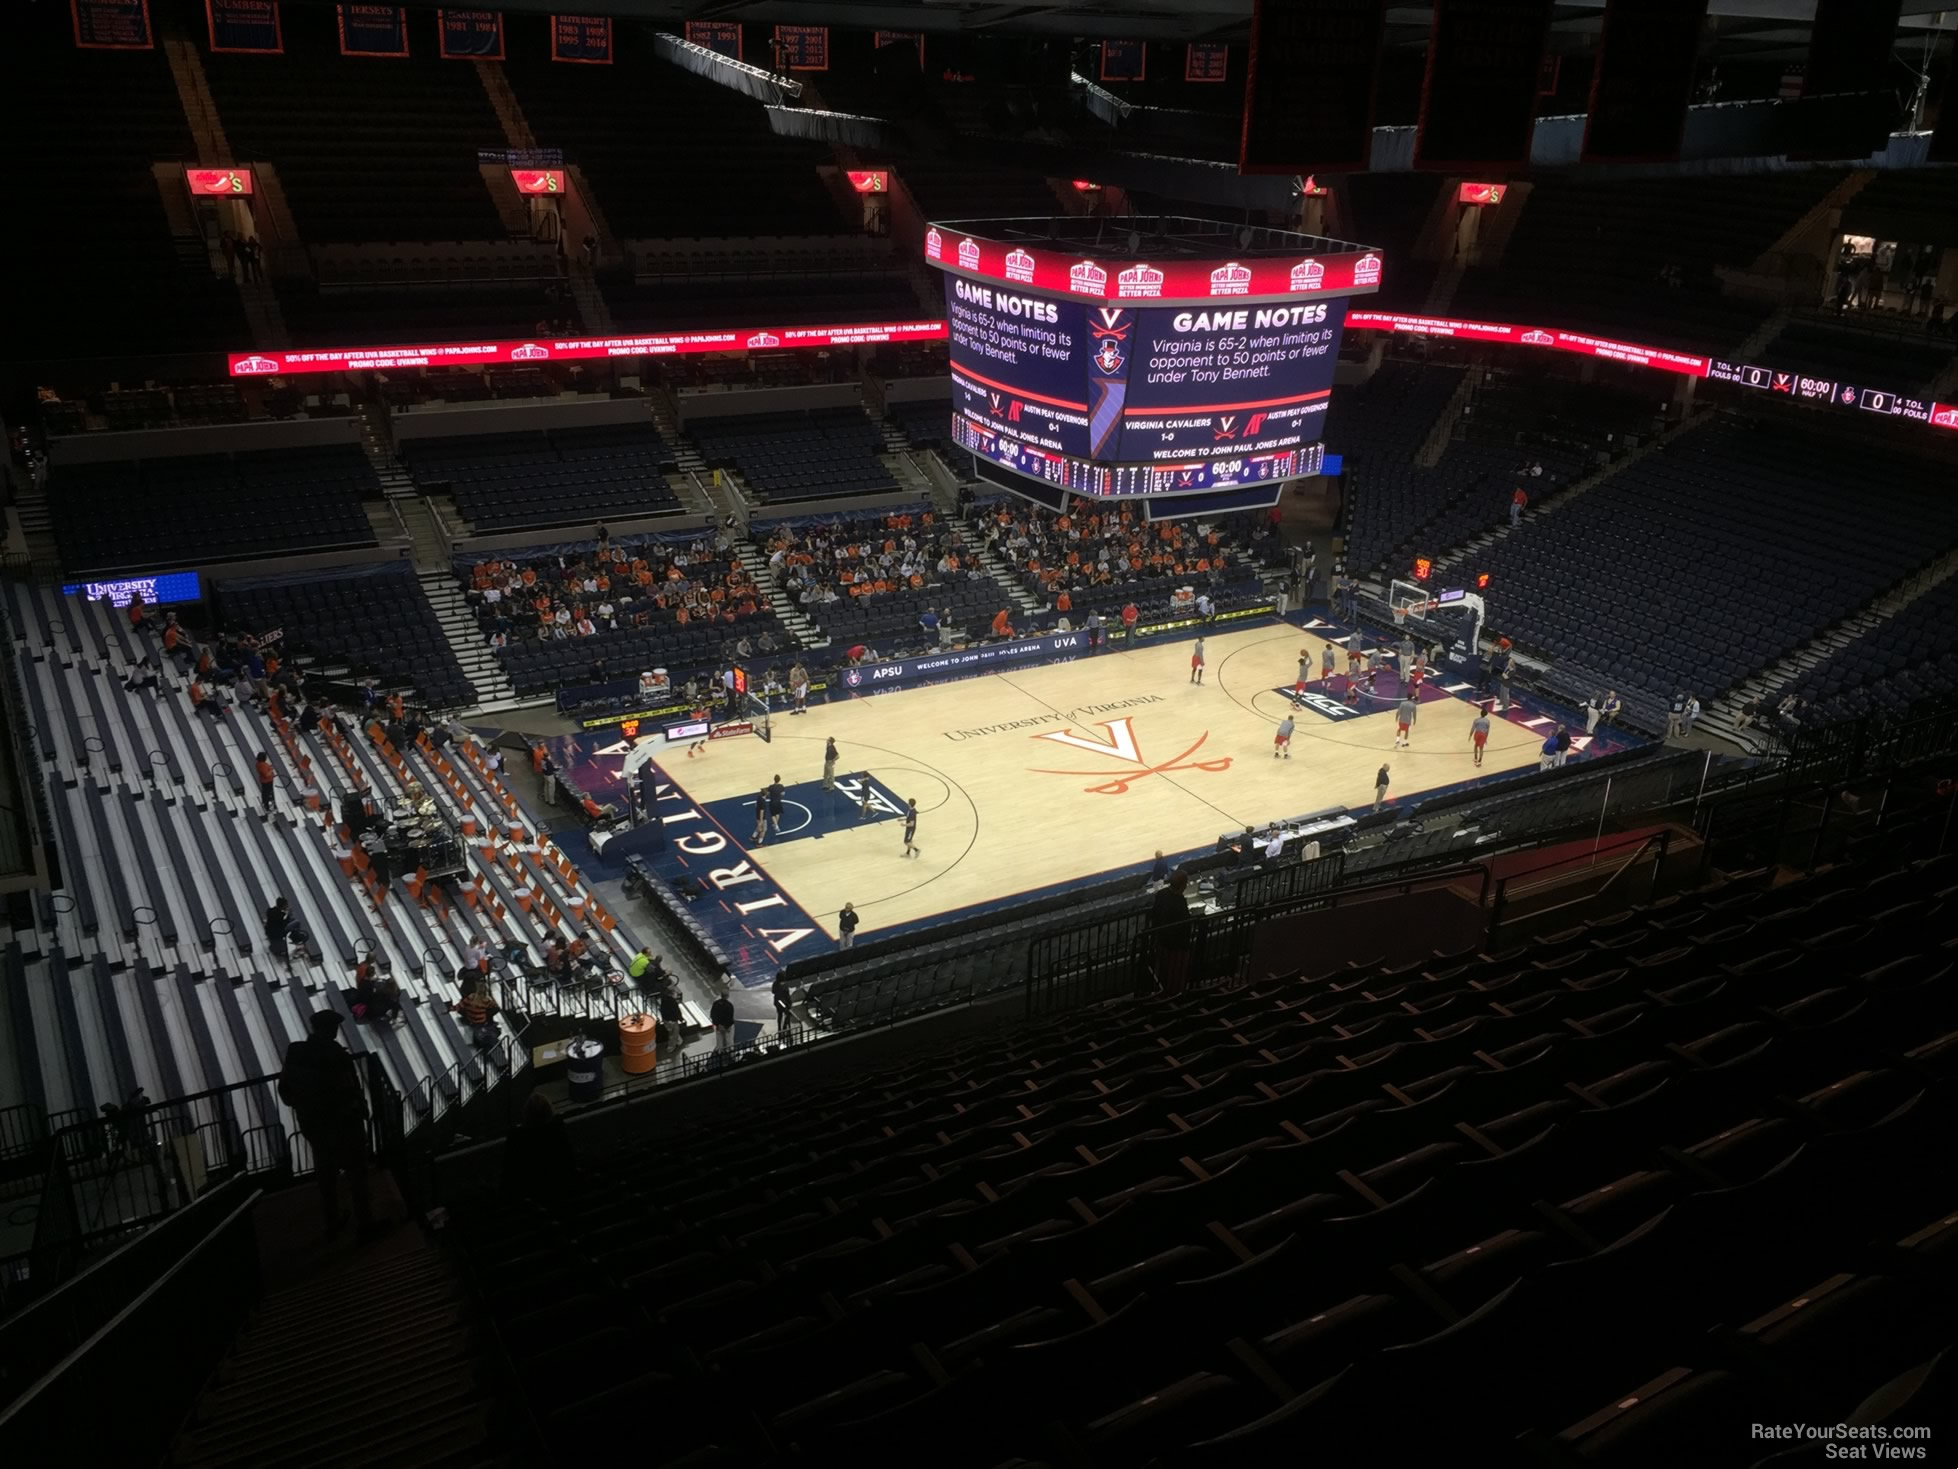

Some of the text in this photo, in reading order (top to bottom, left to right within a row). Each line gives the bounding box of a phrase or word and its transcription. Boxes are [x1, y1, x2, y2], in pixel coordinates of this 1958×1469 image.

[955, 279, 1058, 324] GAME NOTES
[951, 300, 1072, 347] Virginia is 65-2 when limiting its
[1173, 304, 1328, 333] GAME NOTES
[1418, 318, 1448, 328] BASKETBALL
[1449, 321, 1462, 329] WINS
[1468, 323, 1511, 334] PAPAJOHNS.COM
[1394, 323, 1413, 331] PROMO
[1429, 325, 1454, 335] UVAWINS
[951, 317, 1071, 361] opponent to 50 points or fewer
[953, 331, 968, 347] under
[968, 336, 985, 355] Tony
[1152, 328, 1333, 355] Virginia is 65-2 when limiting its
[285, 354, 301, 363] 50%
[301, 354, 314, 362] OFF
[315, 353, 328, 361] THE
[329, 353, 343, 361] DAY
[343, 352, 365, 360] AFTER
[365, 351, 378, 359] UVA
[378, 349, 420, 358] BASKETBALL
[419, 348, 437, 356] WINS
[445, 345, 497, 355] PAPAJOHNS.COM
[1149, 343, 1329, 371] opponent to 50 points or fewer
[348, 357, 428, 368] PROMO CODE: UVAWINS
[1735, 365, 1741, 373] 4
[1147, 370, 1186, 384] under
[1191, 368, 1220, 384] Tony
[1711, 369, 1731, 380] FOULS
[1751, 369, 1761, 385] 0
[1801, 377, 1830, 394] 60:00
[1802, 390, 1816, 398] HALF
[1873, 394, 1884, 409] 0
[1896, 397, 1902, 405] 4
[1024, 404, 1089, 427] AUSTIN PEAY GOVERNORS
[1267, 401, 1329, 420] AUSTIN PEAY GOVERNORS
[1892, 406, 1927, 420] 00 FOULS
[963, 407, 1063, 451] WELCOME TO JOHN PAUL JONES ARENA
[1048, 423, 1060, 432] 0-1
[1125, 418, 1212, 431] VIRGINIA CAVALIERS
[1291, 419, 1302, 428] 0-1
[1161, 432, 1175, 441] 1-0
[999, 438, 1019, 457] 60:00
[1153, 435, 1301, 460] WELCOME TO JOHN PAUL JONES ARENA
[1212, 460, 1242, 475] 60:00
[86, 579, 157, 596] UNIVERSITY
[1054, 637, 1077, 649] UVA
[917, 659, 949, 671] WELCOME
[961, 654, 979, 663] JOHN
[1019, 644, 1041, 653] ARENA
[873, 665, 903, 680] APSU
[1281, 688, 1360, 716] ACC
[942, 712, 1063, 743] UNIVERSITY
[1077, 695, 1167, 728] VIRGINIA
[624, 727, 637, 737] 30
